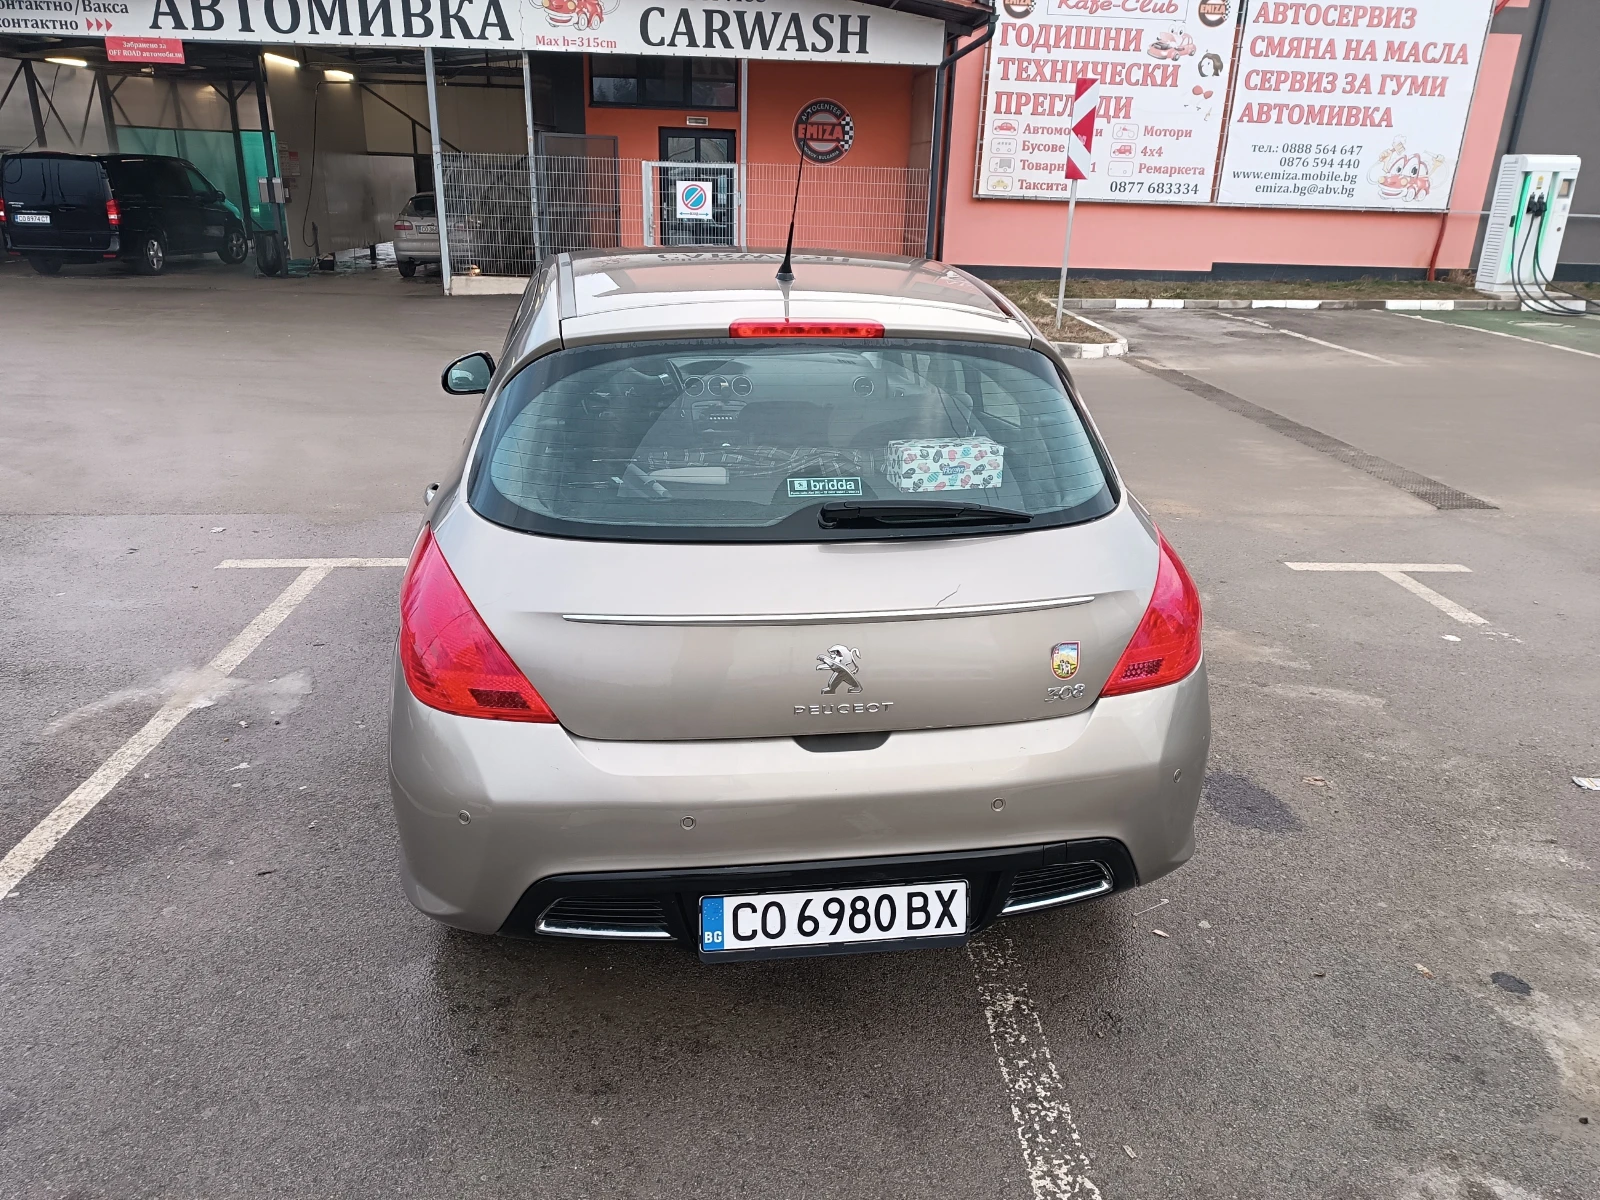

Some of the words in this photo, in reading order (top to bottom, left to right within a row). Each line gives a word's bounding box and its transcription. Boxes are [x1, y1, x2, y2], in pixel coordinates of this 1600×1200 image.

[1200, 4, 1226, 14] EMIZA
[1253, 2, 1418, 29] АВТОСЕРВИЗ
[0, 17, 79, 30] онтактно
[149, 0, 515, 41] АВТОМИВКА
[639, 6, 871, 54] CARWASH
[535, 35, 560, 46] Max
[562, 36, 617, 48] h=315cm
[1000, 22, 1144, 53] ГОДИШНИ
[1249, 35, 1337, 60] СМЯНА
[1343, 39, 1377, 61] НА
[1383, 40, 1469, 65] МАСЛА
[997, 57, 1181, 87] ТЕХНИЧЕСКИ
[1244, 69, 1339, 94] СЕРВИЗ
[1342, 72, 1372, 95] ЗА
[1378, 73, 1449, 97] ГУМИ
[993, 91, 1134, 124] ПРЕГЛДИ
[1237, 102, 1394, 128] АВТОМИВКА
[798, 124, 843, 139] EMIZA
[1143, 125, 1193, 139] Мотори
[1022, 140, 1065, 154] Бусове
[1140, 146, 1164, 157] 4x4
[1251, 144, 1279, 153] тел.:
[1281, 143, 1312, 154] 0888
[1314, 144, 1337, 155] 564
[1340, 145, 1363, 156] 647
[1020, 159, 1065, 173] Товарн
[1138, 163, 1206, 177] Ремаркета
[1279, 157, 1309, 168] 0876
[1312, 157, 1335, 168] 594
[1337, 158, 1360, 169] 440
[1232, 169, 1358, 185] www.emiza.mobile.bg
[1018, 179, 1068, 191] Таксита
[1110, 181, 1144, 193] 0877
[1148, 182, 1200, 195] 683334
[1255, 183, 1355, 198] emiza.bg@abv.bg
[811, 480, 855, 491] bridda
[1044, 683, 1086, 703] 308
[793, 702, 894, 715] PEUGEOT
[732, 902, 787, 941] CO
[797, 893, 897, 937] 6980
[906, 889, 958, 931] BX
[704, 931, 723, 944] BG
